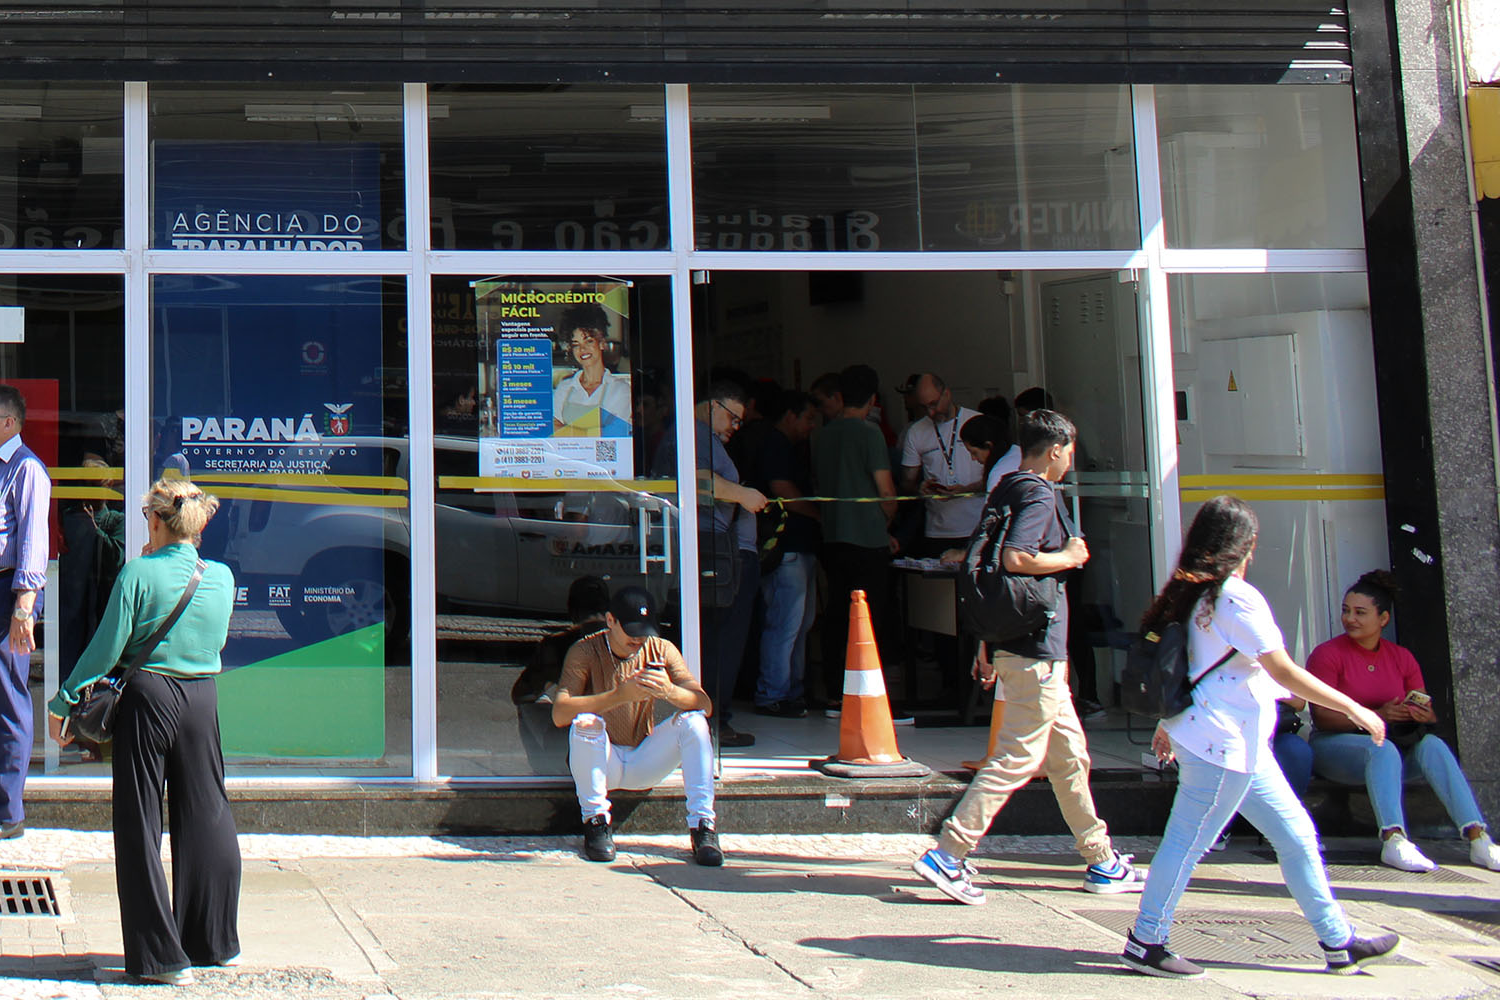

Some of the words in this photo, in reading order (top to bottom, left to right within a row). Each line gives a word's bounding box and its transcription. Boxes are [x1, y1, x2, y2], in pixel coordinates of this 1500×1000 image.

[172, 209, 303, 233] AGÊNCIA
[323, 214, 362, 233] DO
[501, 291, 605, 304] MICROCRÉDITO
[501, 305, 541, 318] FÁCIL
[182, 413, 319, 441] PARANÁ
[182, 448, 256, 456] GOVERNO
[267, 448, 286, 456] DO
[298, 448, 358, 456] ESTADO
[205, 459, 267, 469] SECRETARIA
[269, 460, 284, 469] DA
[286, 459, 331, 471] JUSTIÇA,
[268, 586, 291, 598] FAT
[303, 586, 343, 595] MINISTÉRIO
[345, 587, 356, 595] DA
[303, 595, 342, 603] ECONOMIA
